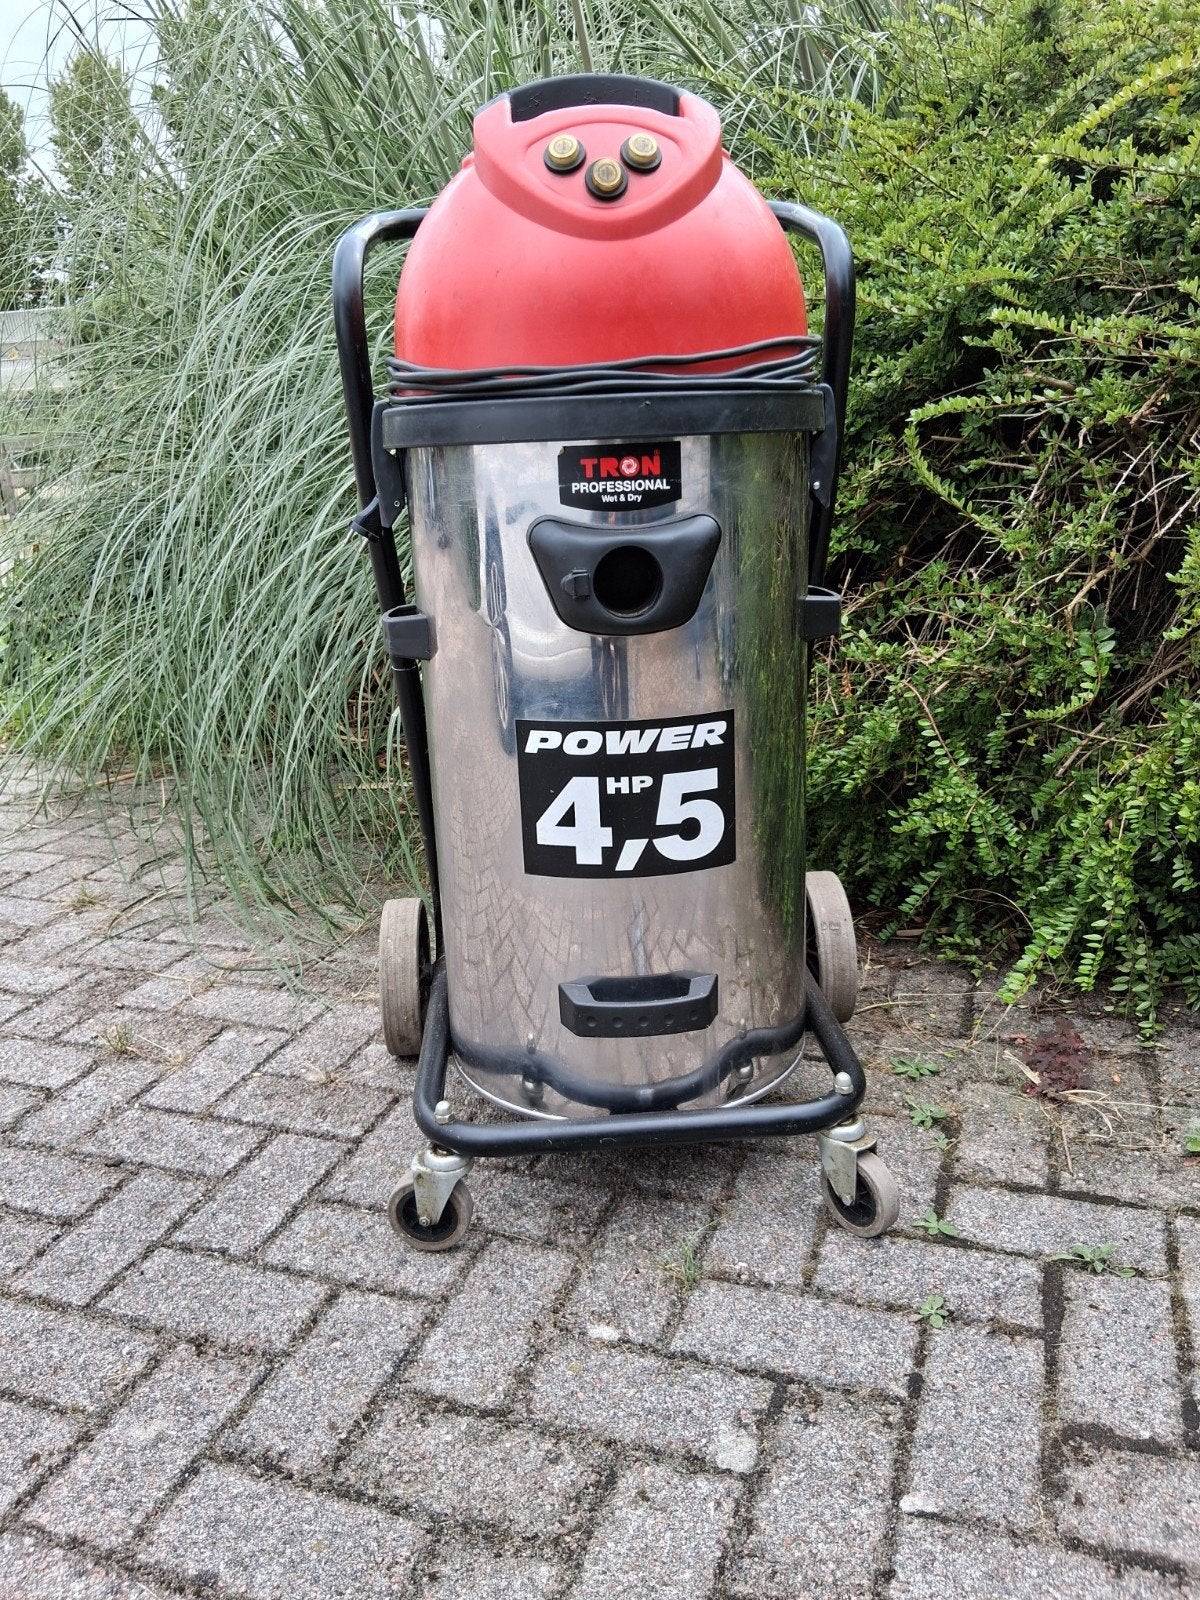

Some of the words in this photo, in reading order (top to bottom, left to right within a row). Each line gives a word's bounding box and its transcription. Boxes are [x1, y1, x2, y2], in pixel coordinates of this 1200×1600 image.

[580, 456, 661, 478] TRON
[572, 479, 670, 494] PROFESSIONAL
[602, 494, 617, 502] Wet
[628, 494, 642, 502] Dry
[525, 720, 727, 755] POWER
[606, 776, 653, 794] HP
[536, 768, 725, 871] 4,5
